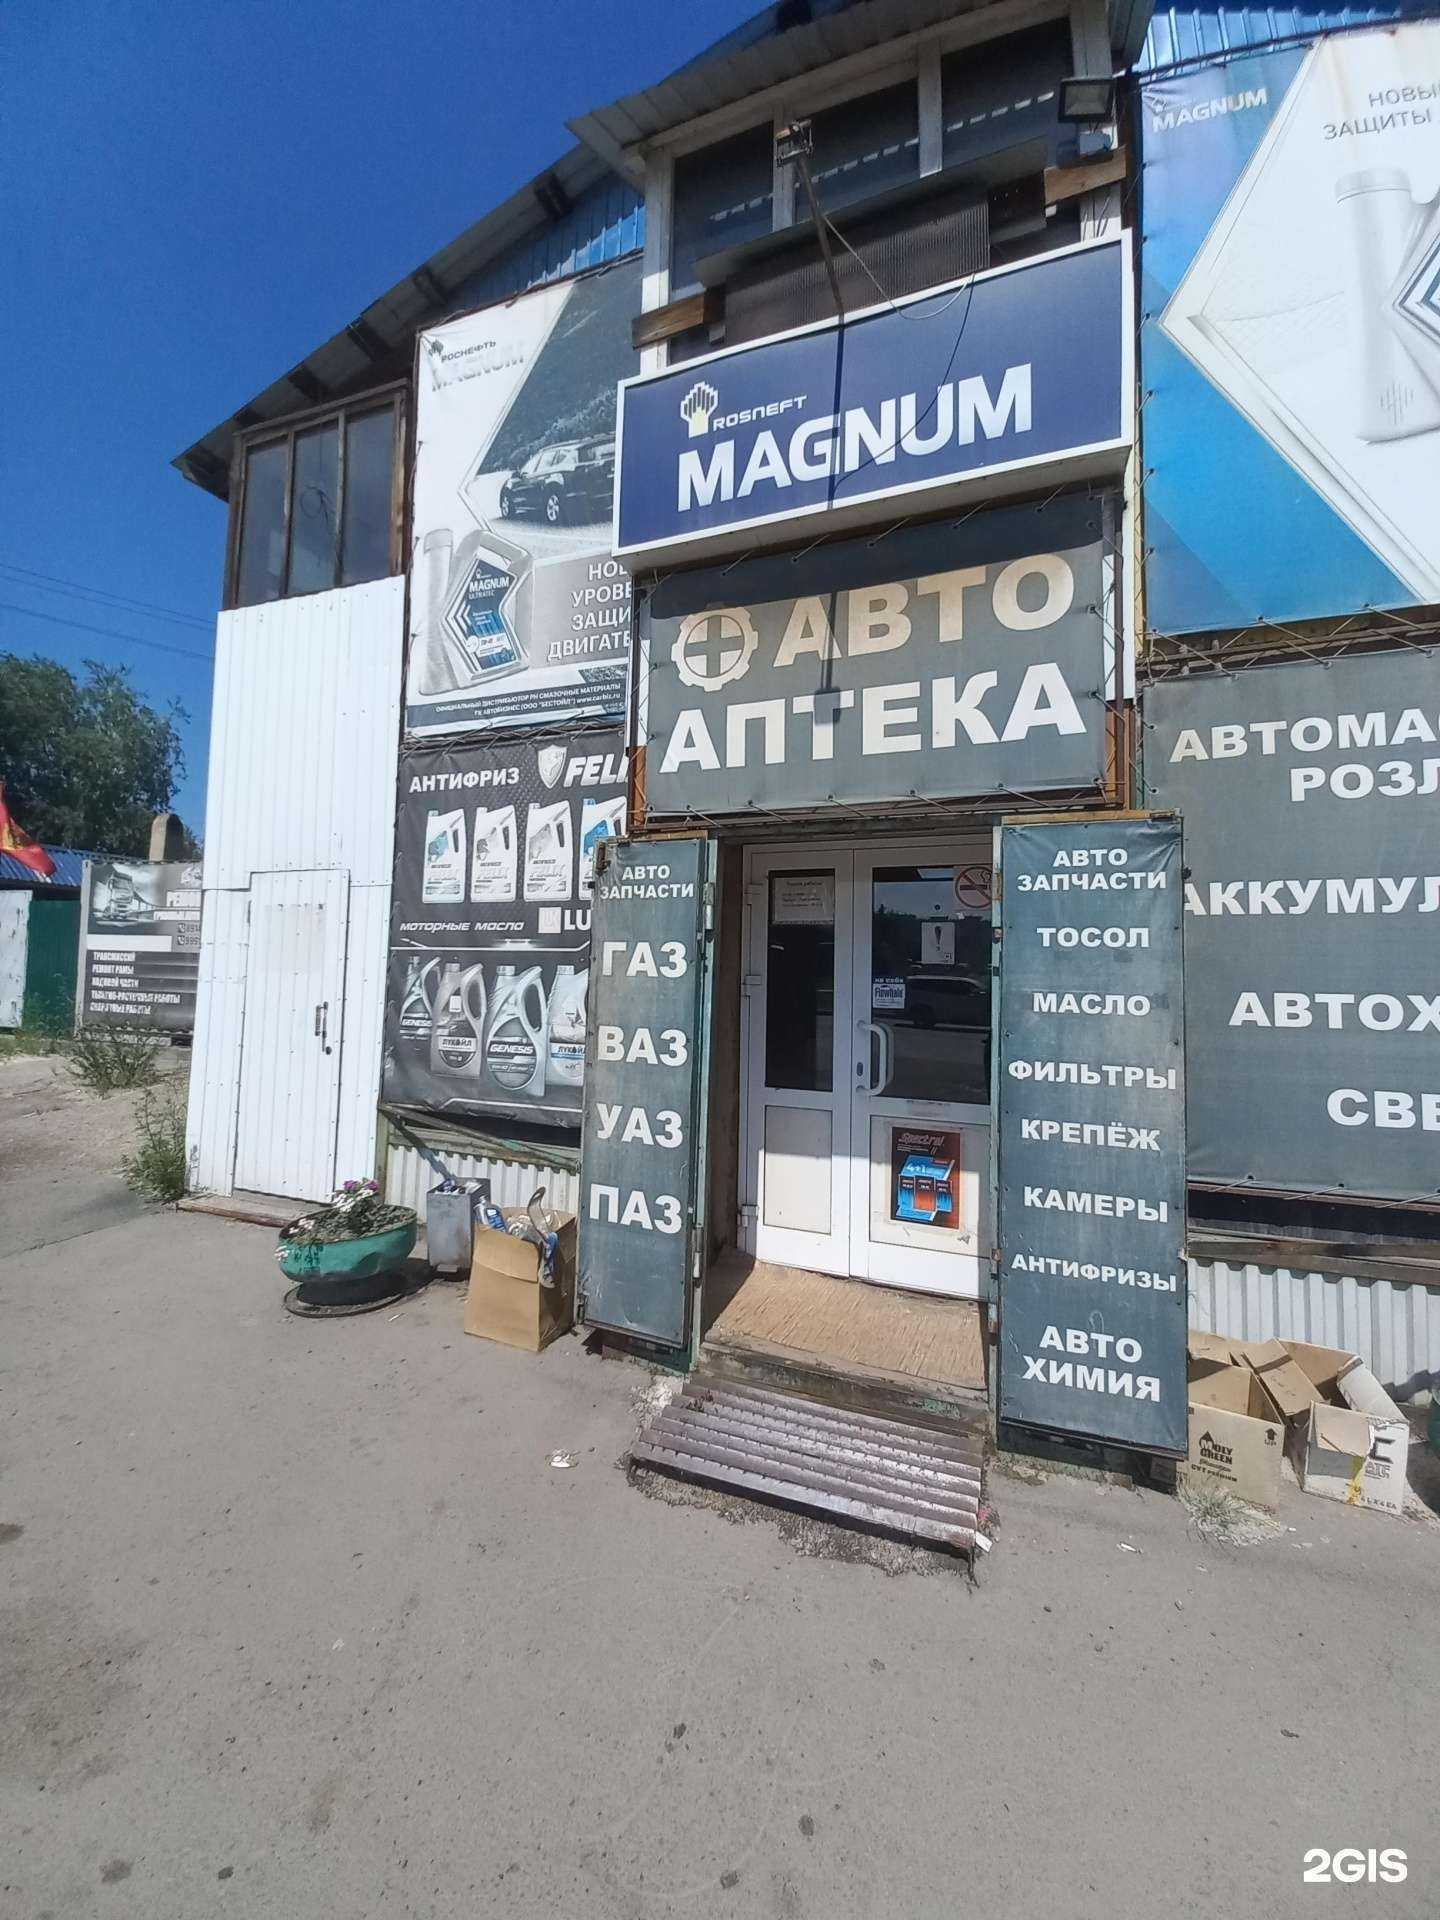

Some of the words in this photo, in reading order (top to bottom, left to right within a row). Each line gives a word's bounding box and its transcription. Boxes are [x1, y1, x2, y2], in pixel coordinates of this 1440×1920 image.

[1152, 87, 1268, 133] MAGNUM
[1369, 80, 1440, 108] НОВЫ
[1323, 107, 1432, 140] ЗАЩИТЫ
[441, 341, 497, 363] РОСНЕФТЬ
[713, 394, 808, 432] ROSNEFT
[677, 362, 1032, 512] MAGNUM
[469, 576, 510, 593] MAGNUM
[773, 553, 1074, 668] АВТО
[658, 662, 1087, 774] АПТЕКА
[1169, 708, 1440, 763] АВТОМА
[409, 767, 520, 793] АНТИФРИЗ
[622, 865, 671, 881] АВТО
[1053, 848, 1128, 868] АВТО
[600, 883, 694, 900] ЗАПЧАСТИ
[1017, 871, 1167, 891] ЗАПЧАСТИ
[400, 921, 471, 933] моторные
[1036, 927, 1149, 948] ТОСОЛ
[602, 941, 688, 978] ГАЗ
[1033, 992, 1150, 1016] МАСЛО
[490, 1043, 534, 1055] GENESIS
[597, 1025, 688, 1067] ВАЗ
[1008, 1060, 1176, 1090] ФИЛЬТРЫ
[596, 1103, 683, 1148] УАЗ
[1021, 1118, 1160, 1150] КРЕПЁЖ
[589, 1183, 682, 1234] ПАЗ
[1023, 1186, 1168, 1223] КАМЕРЫ
[1011, 1253, 1176, 1292] АНТИФРИЗЫ
[1039, 1325, 1143, 1363] АВТО
[1022, 1355, 1160, 1402] ХИМИЯ
